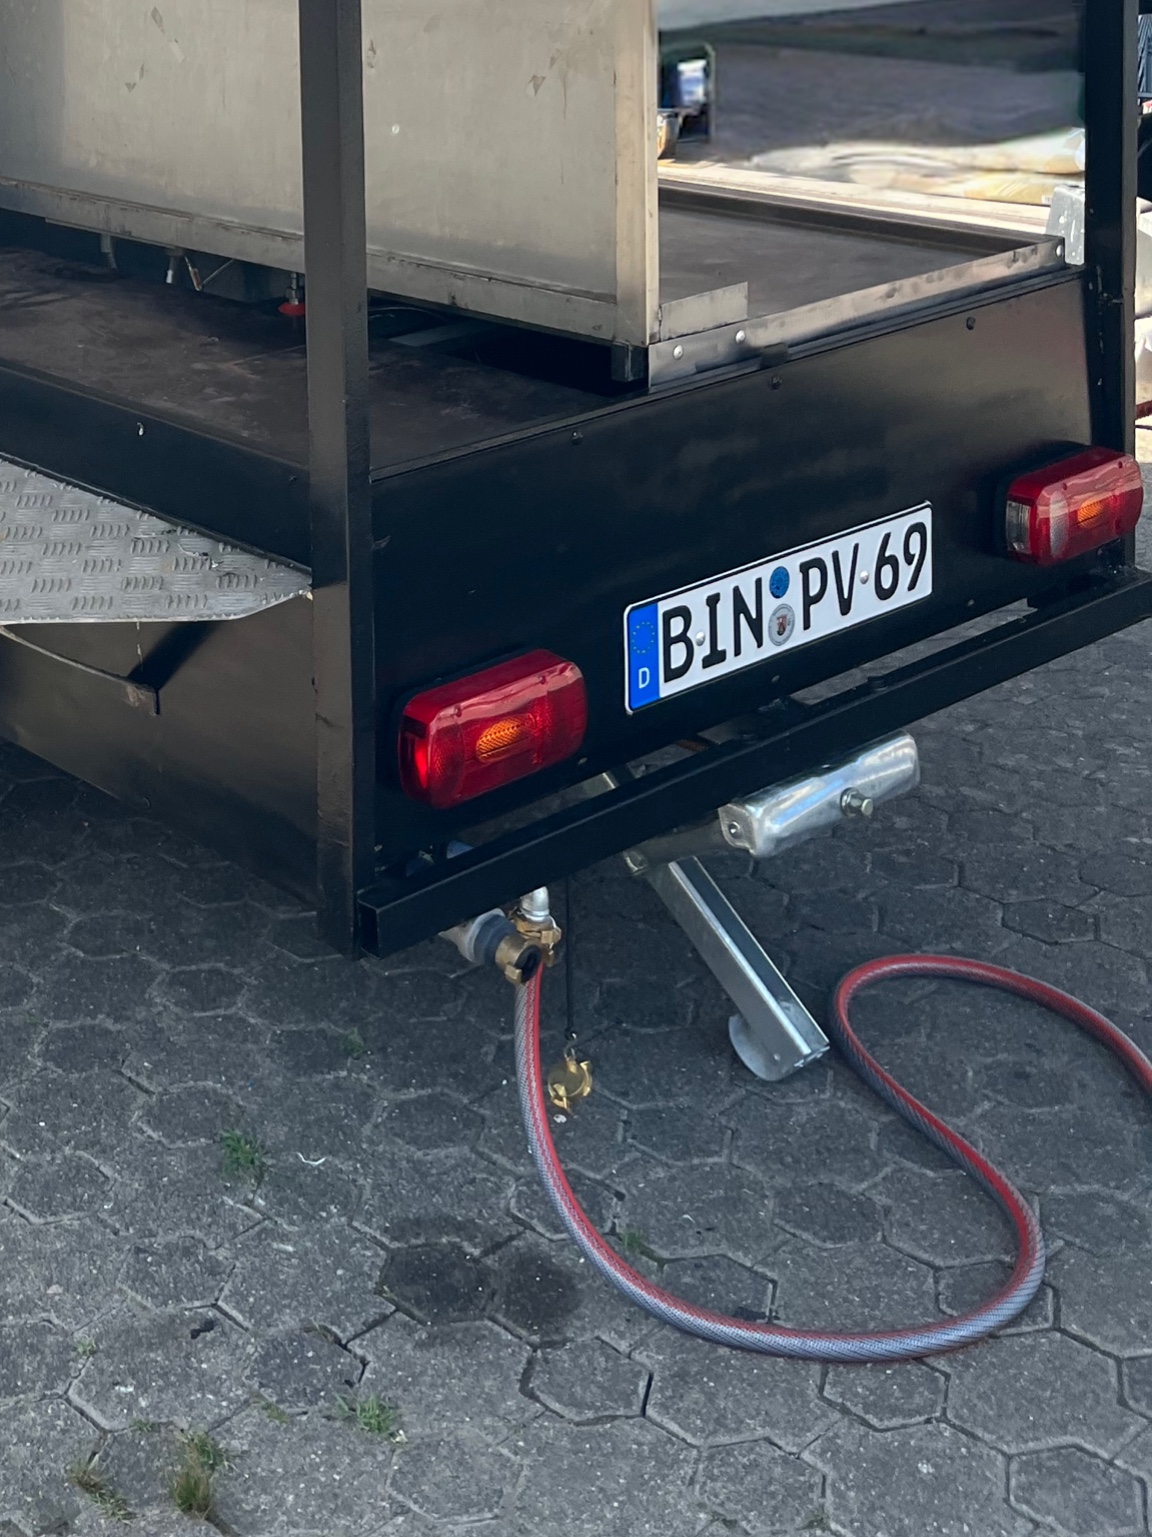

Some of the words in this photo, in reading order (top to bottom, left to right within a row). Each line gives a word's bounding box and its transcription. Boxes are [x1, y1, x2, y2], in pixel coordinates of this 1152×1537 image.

[662, 577, 764, 684] BIN
[799, 542, 860, 631] PV
[874, 521, 928, 601] 69
[638, 667, 650, 689] D
